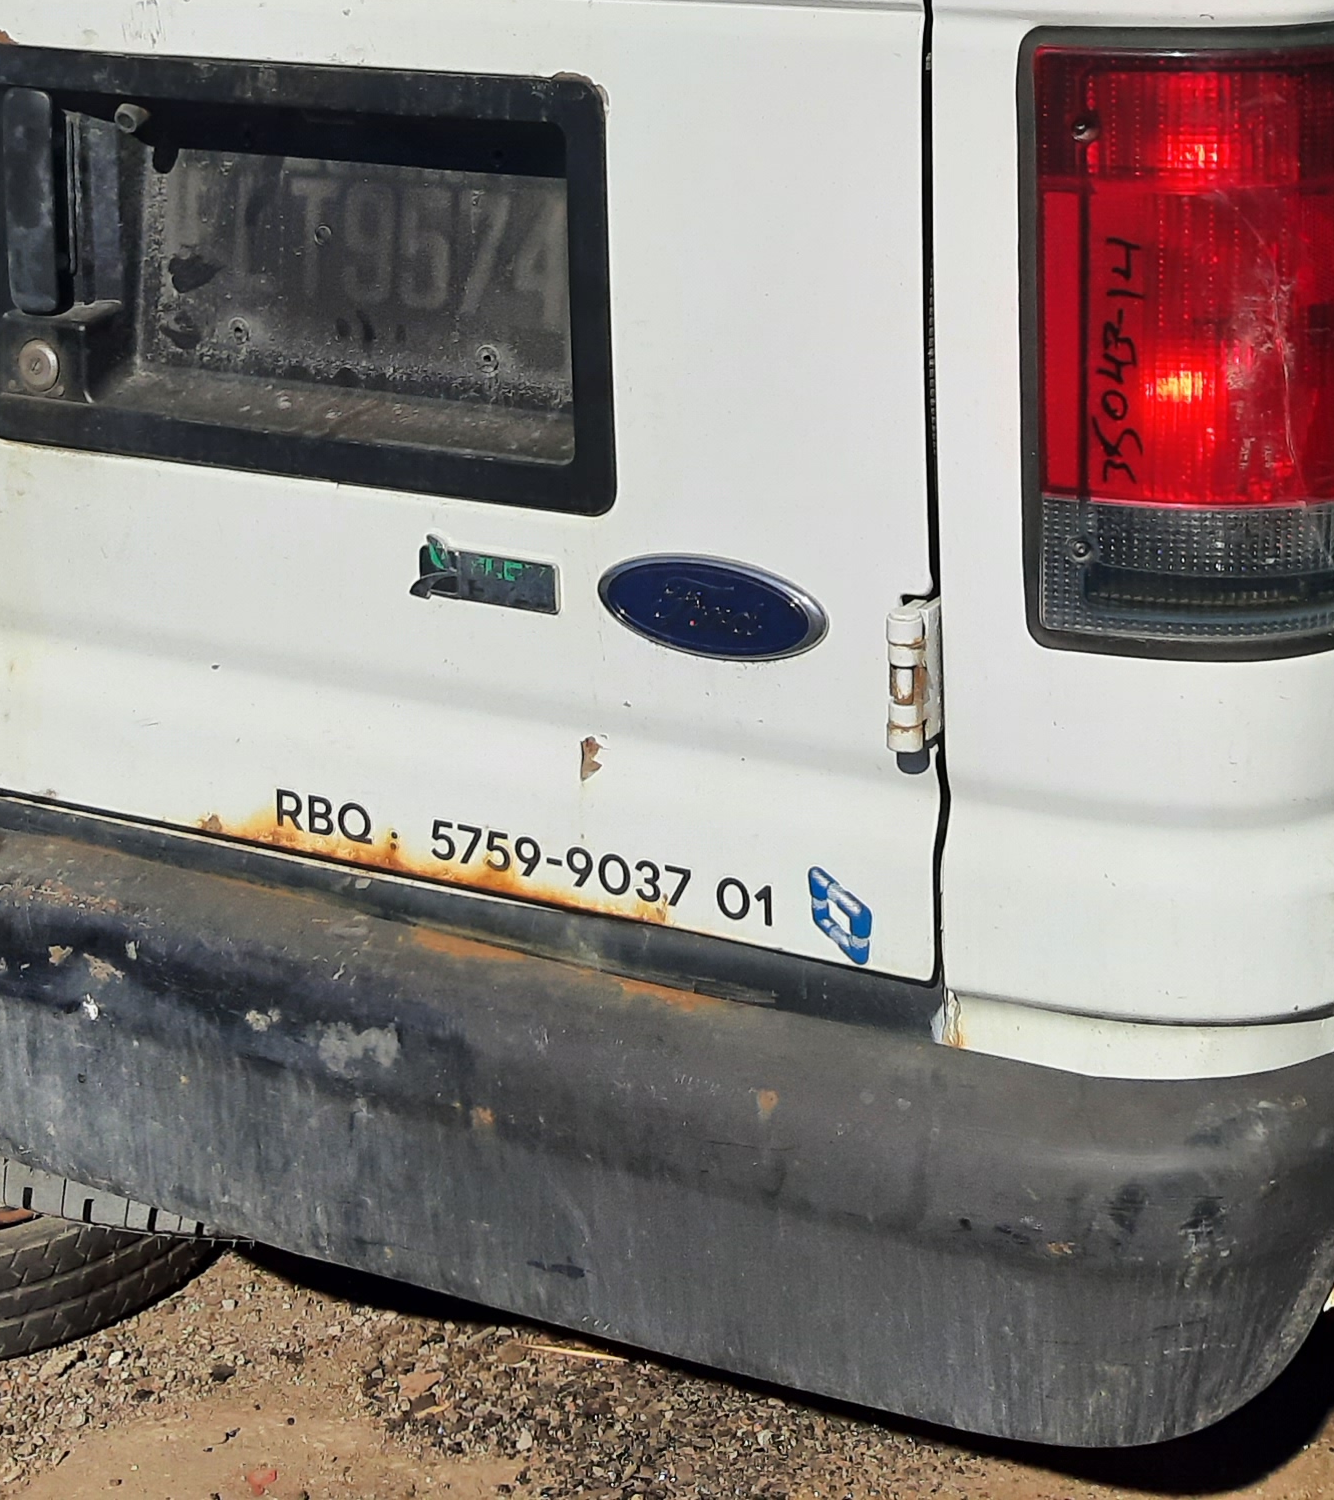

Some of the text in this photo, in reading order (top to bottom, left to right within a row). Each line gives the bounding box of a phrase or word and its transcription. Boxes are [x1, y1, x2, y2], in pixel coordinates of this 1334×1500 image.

[1090, 235, 1146, 485] 35043-14
[431, 818, 692, 908] 5759-9037
[716, 876, 773, 927] 01
